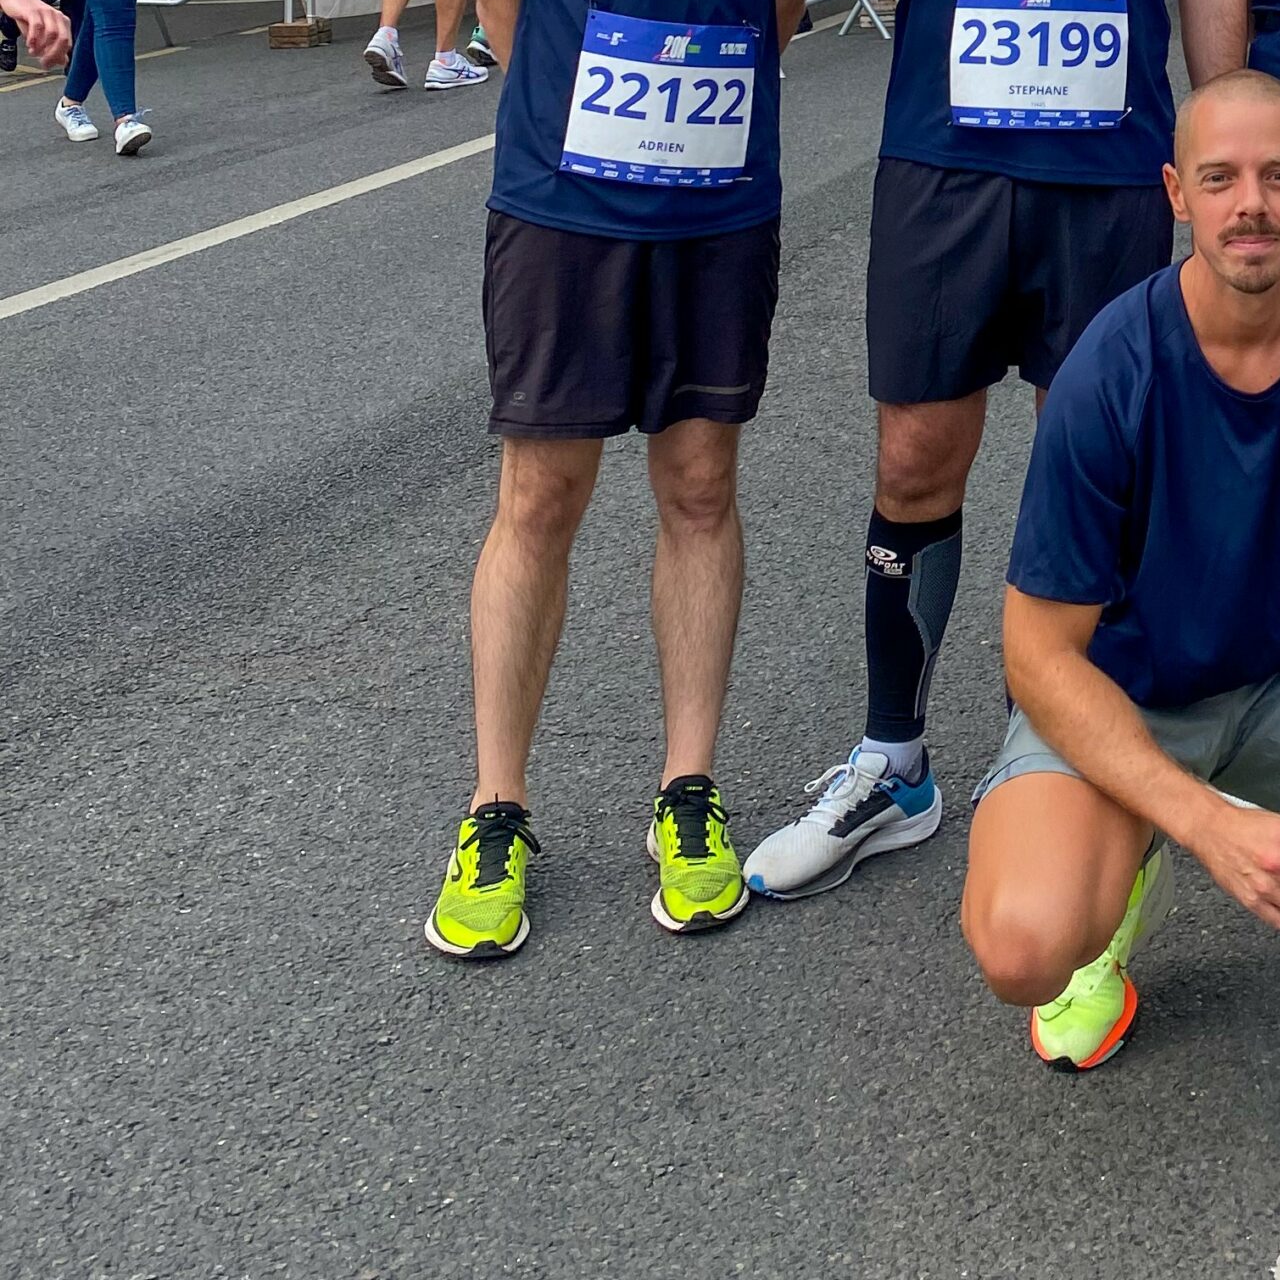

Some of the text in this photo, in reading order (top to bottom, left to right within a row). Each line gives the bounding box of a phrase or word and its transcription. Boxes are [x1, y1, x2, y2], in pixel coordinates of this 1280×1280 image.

[959, 19, 1121, 68] 23199
[581, 66, 746, 125] 22122
[1008, 85, 1069, 96] STEPHANE
[638, 140, 685, 153] ADRIEN
